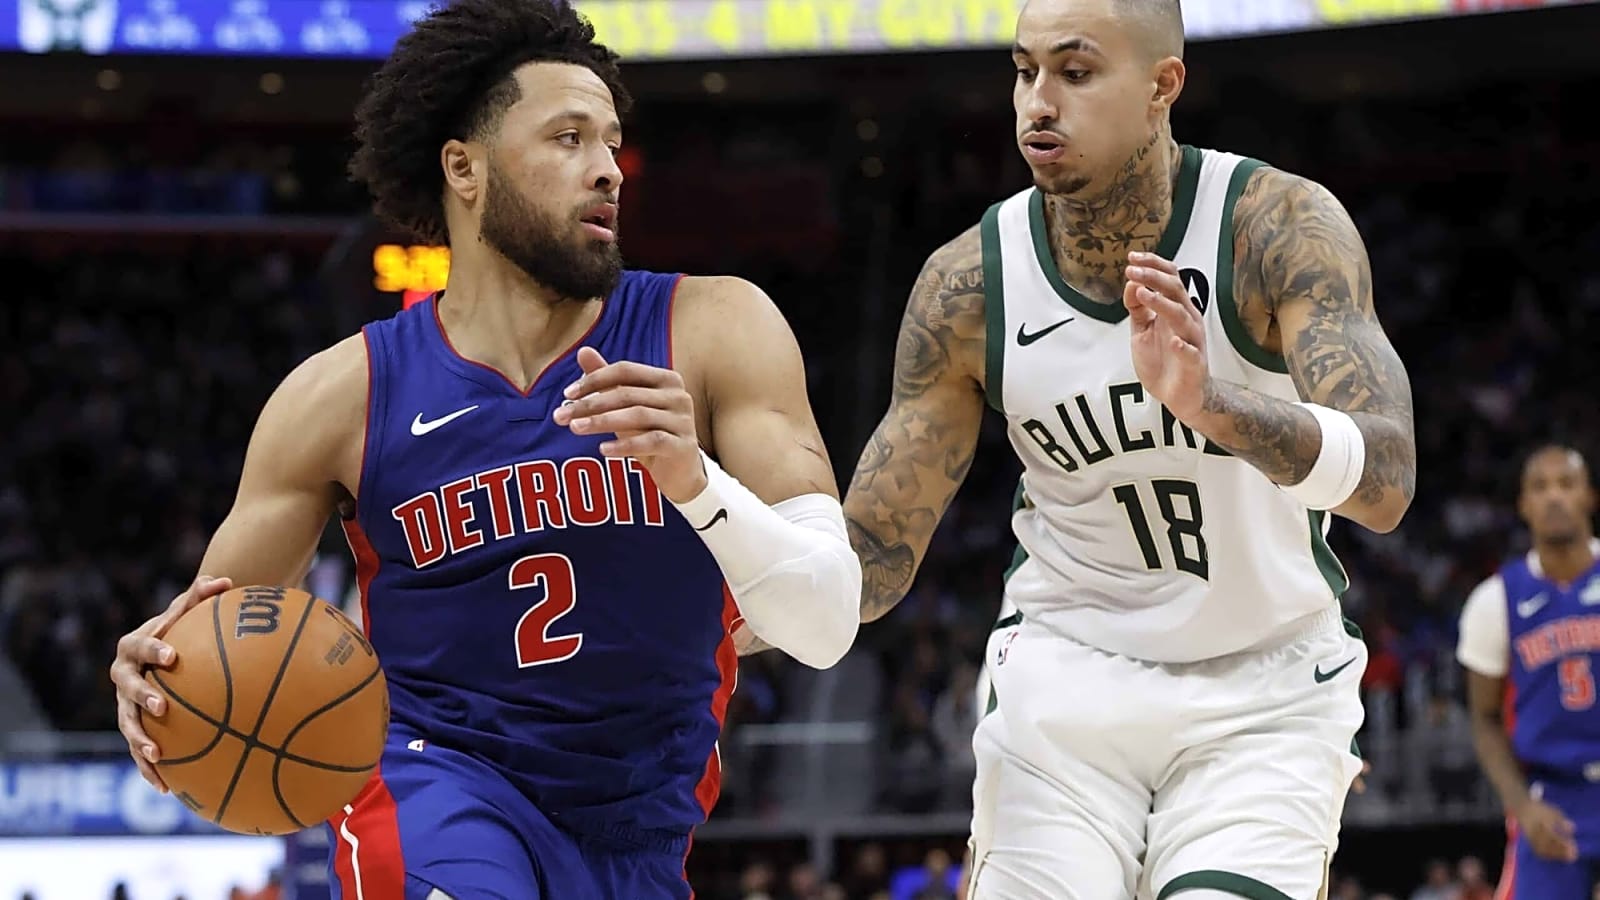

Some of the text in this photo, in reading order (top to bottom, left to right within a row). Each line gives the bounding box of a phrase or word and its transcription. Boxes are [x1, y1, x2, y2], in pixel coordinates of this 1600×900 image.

[950, 271, 984, 290] KU
[1020, 381, 1236, 474] BUCK
[392, 456, 664, 568] DETROIT
[1111, 478, 1210, 583] 18
[508, 552, 583, 669] 2
[1558, 654, 1596, 711] 5
